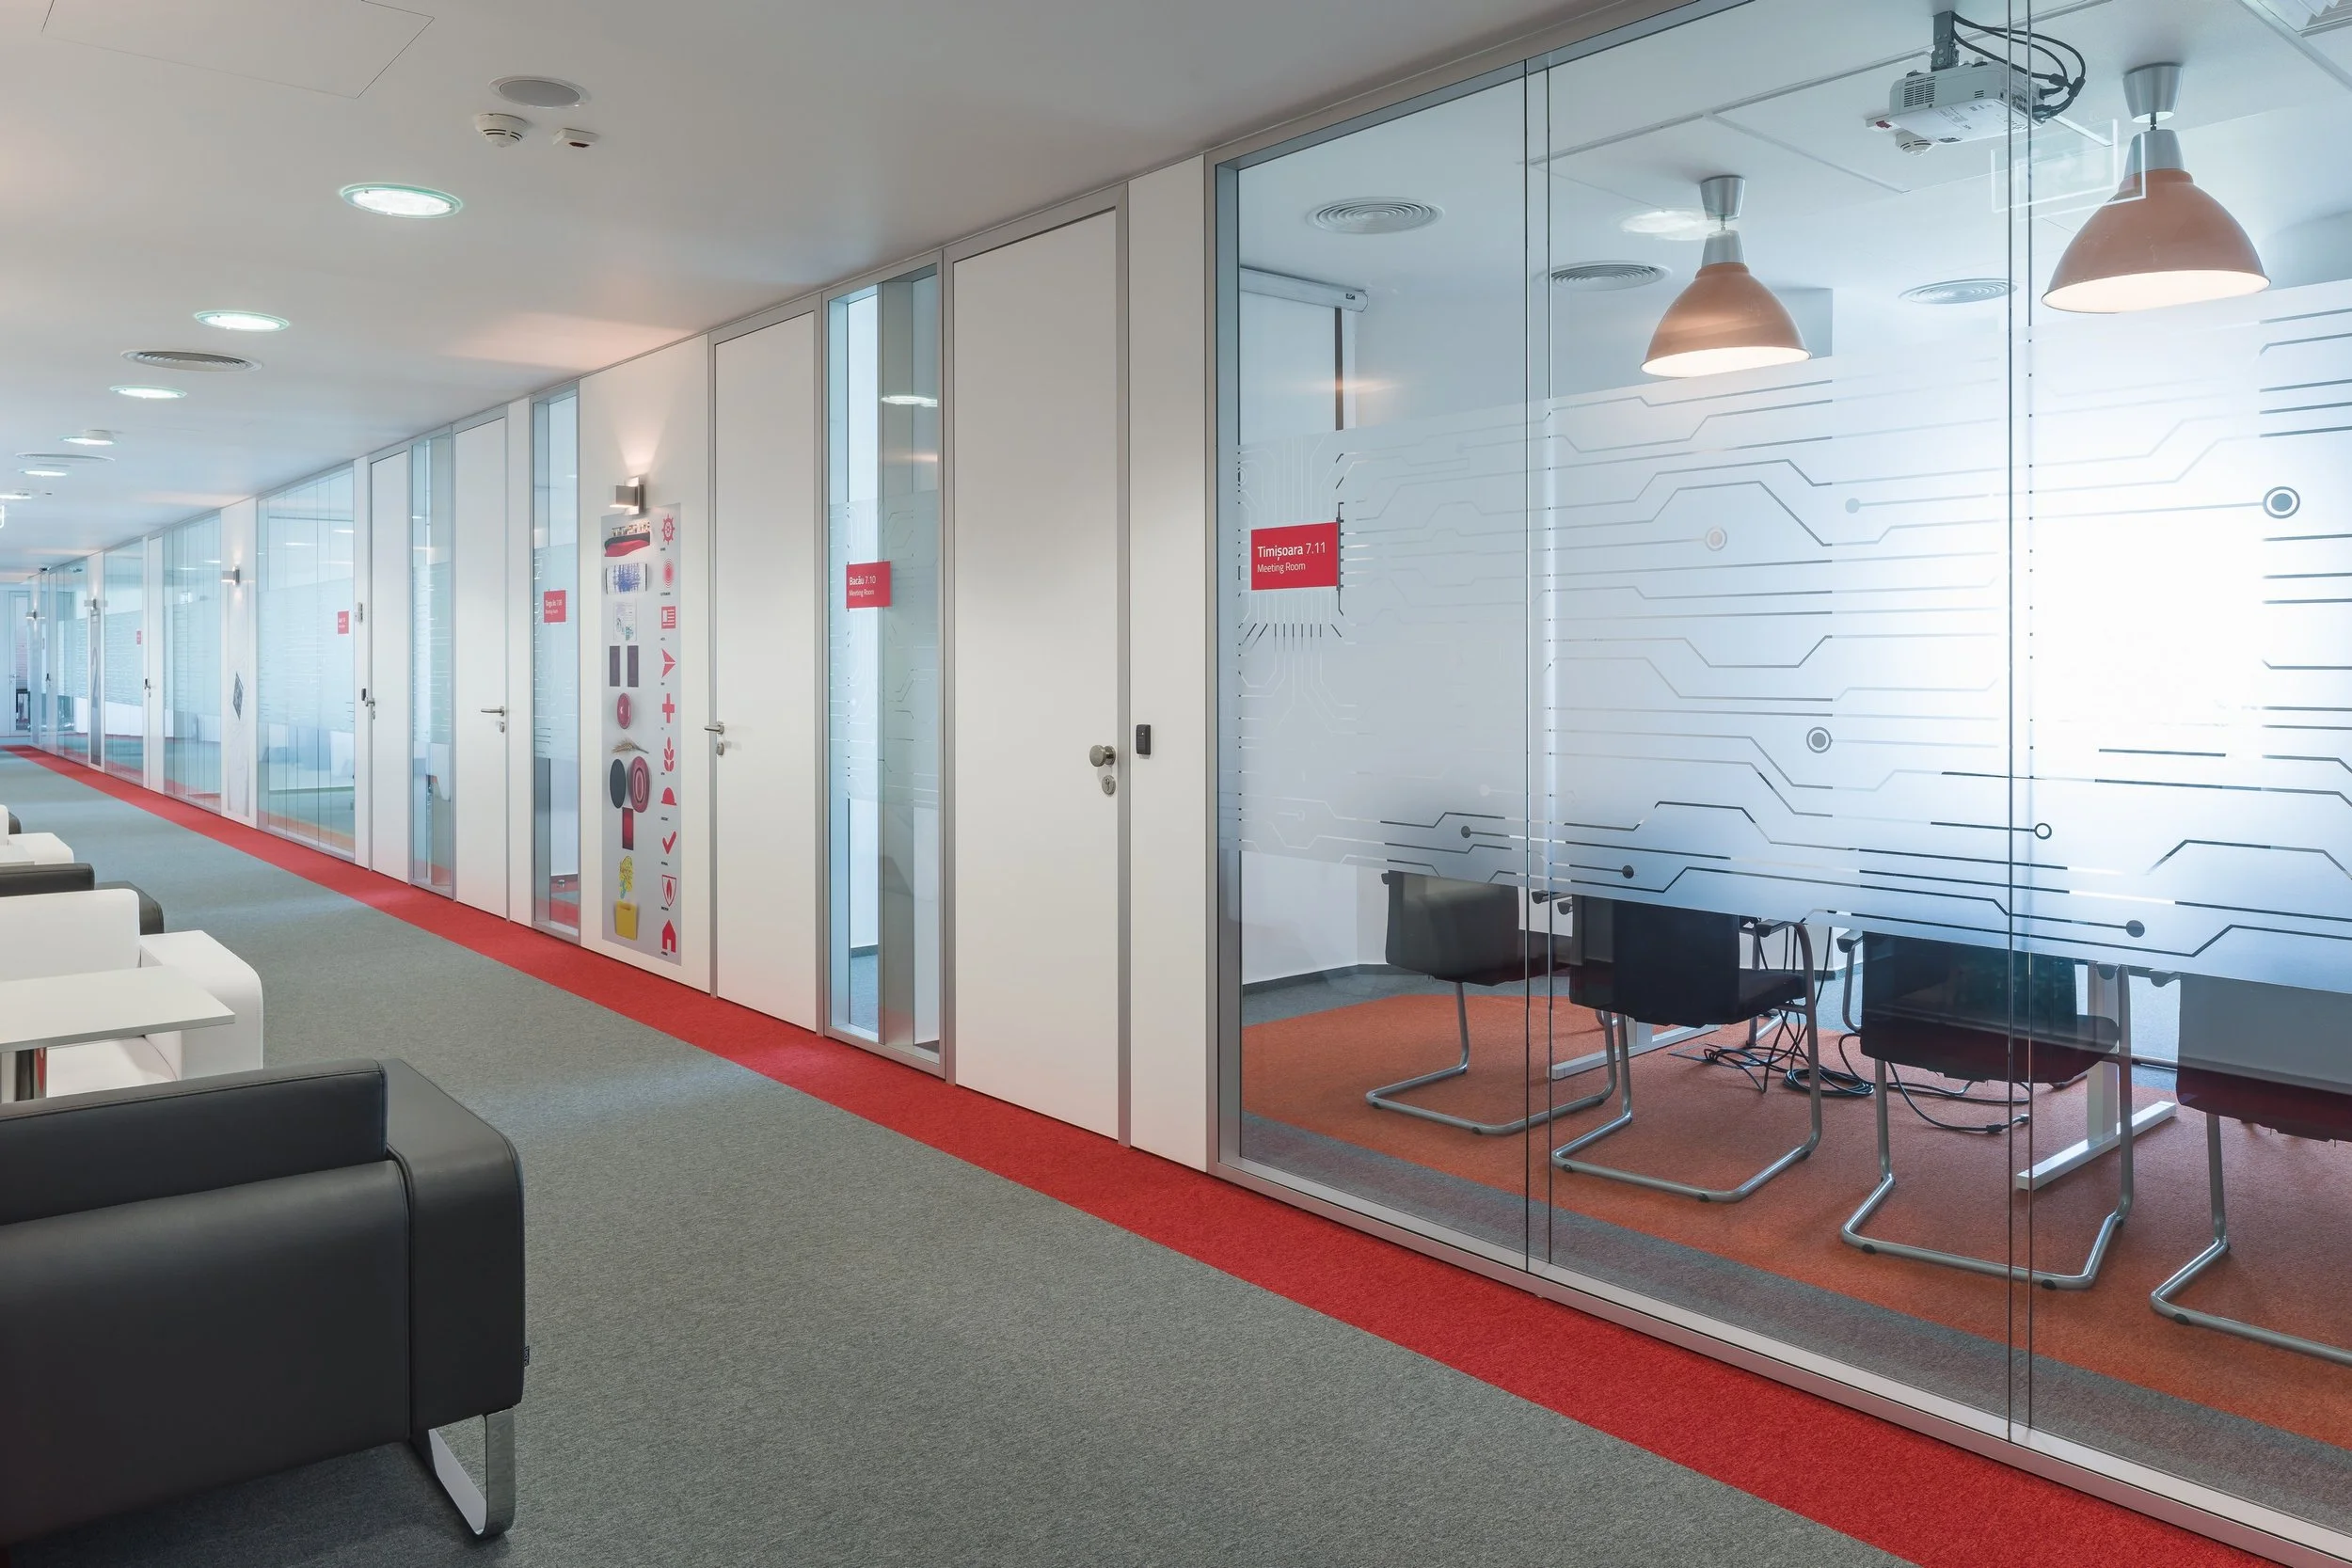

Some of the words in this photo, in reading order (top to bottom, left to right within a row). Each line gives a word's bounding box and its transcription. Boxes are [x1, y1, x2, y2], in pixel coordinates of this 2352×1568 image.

[1257, 545, 1304, 562] Timișoara
[1305, 541, 1326, 554] 7.11
[1257, 562, 1284, 575] Meeting
[1285, 562, 1306, 572] Room
[865, 575, 876, 584] 7.10
